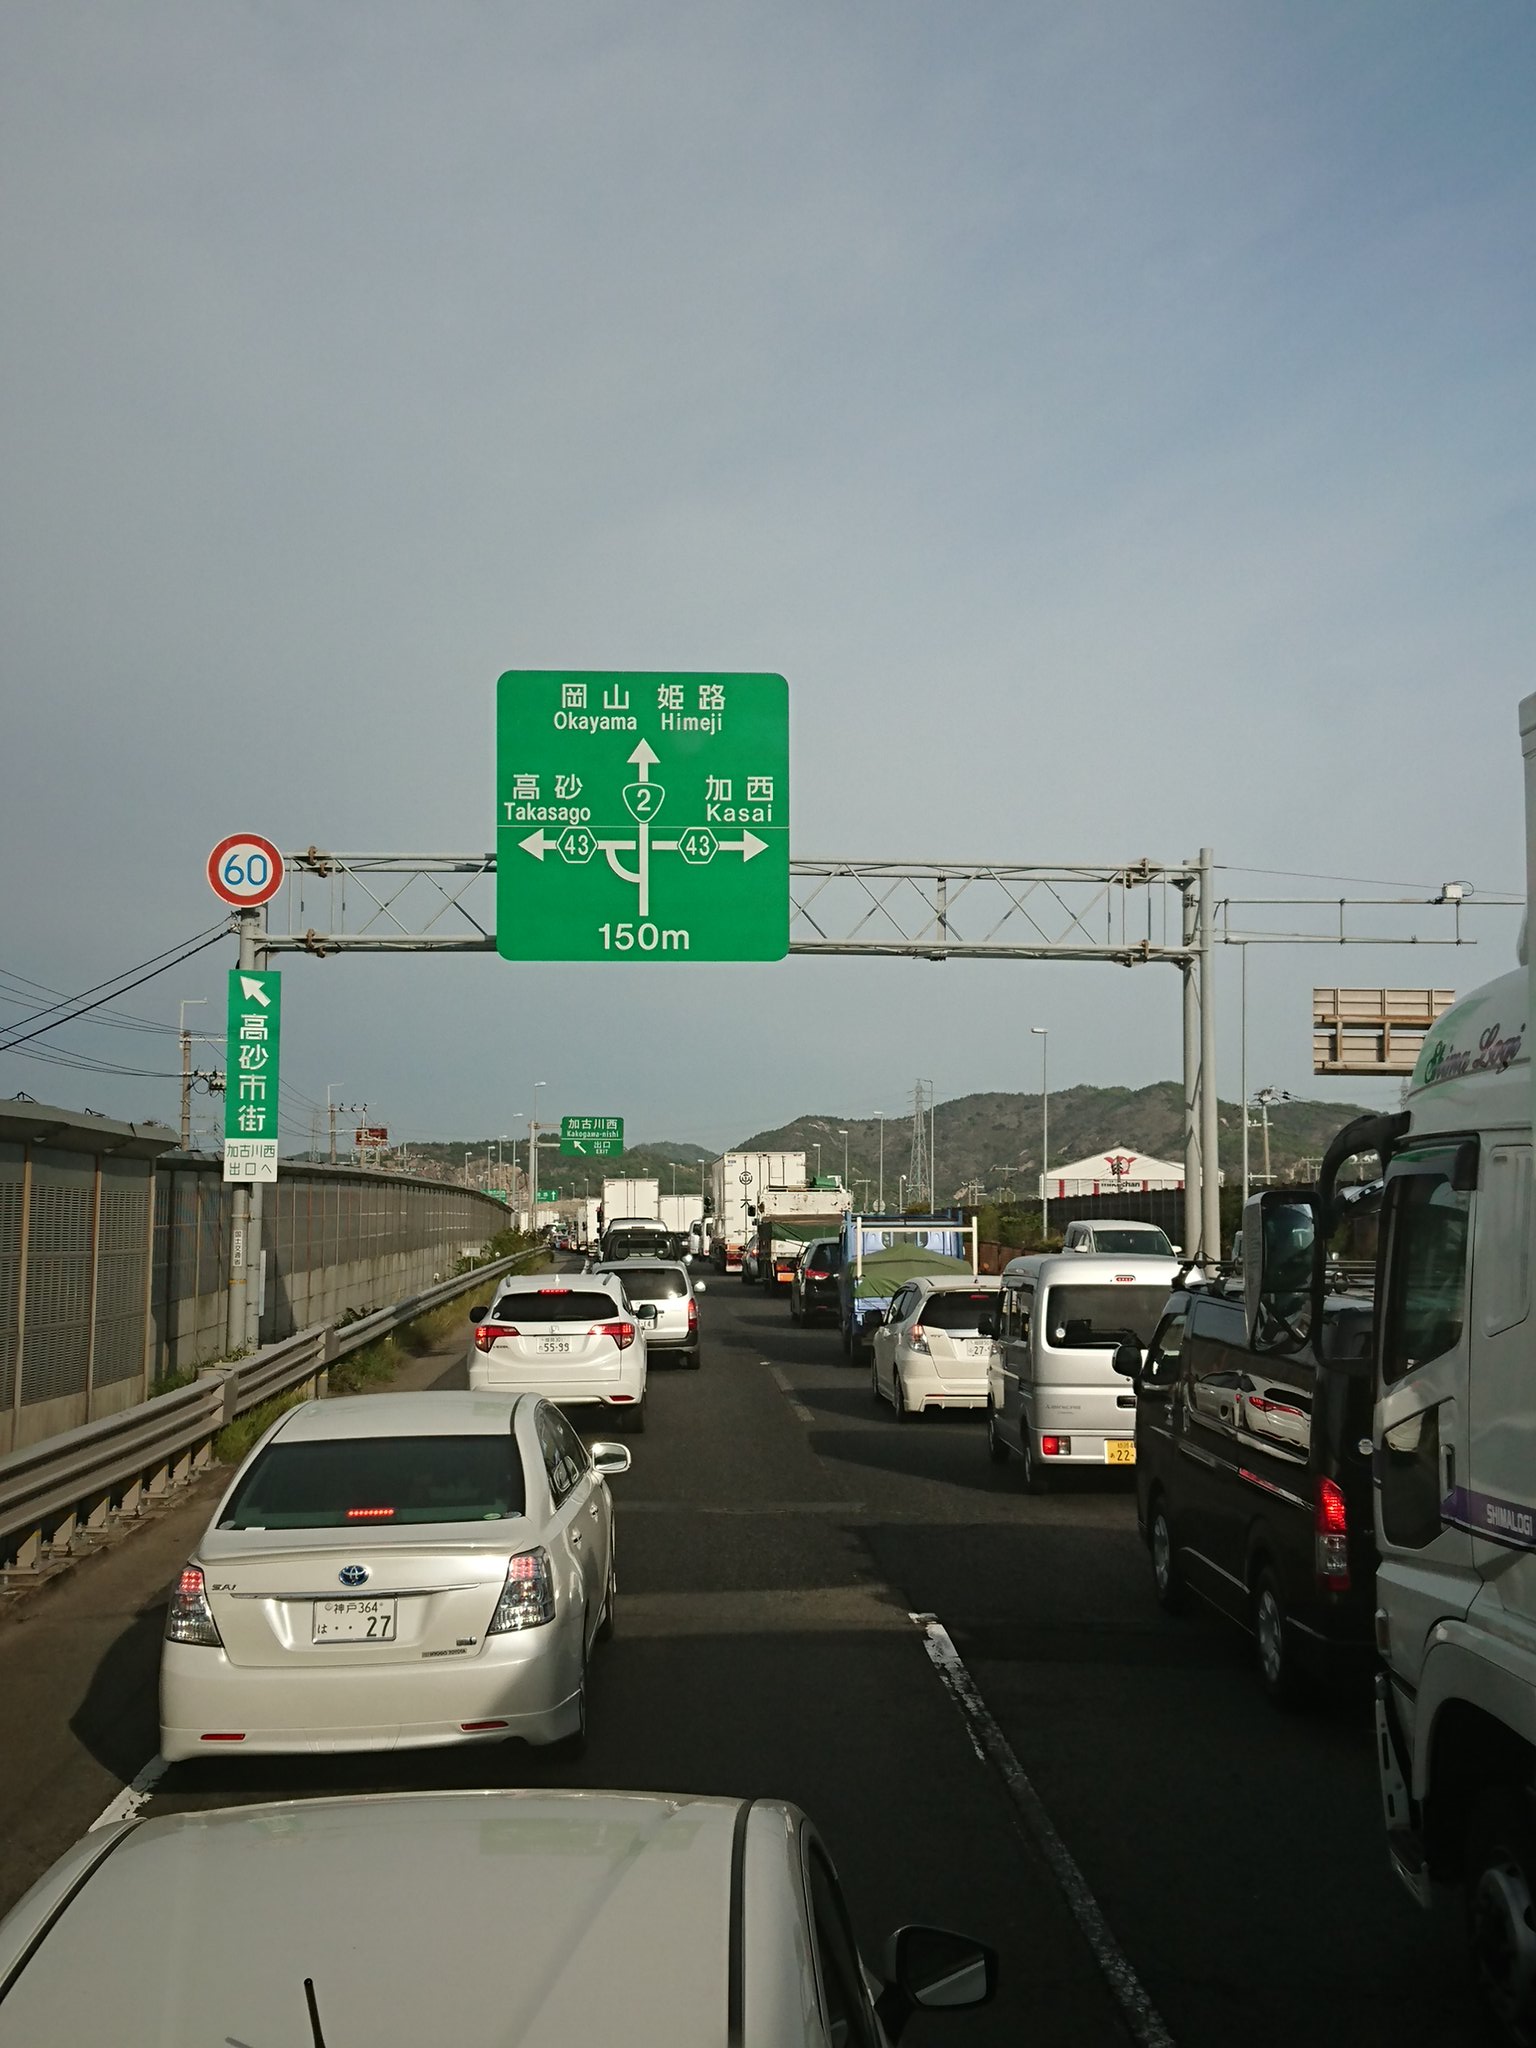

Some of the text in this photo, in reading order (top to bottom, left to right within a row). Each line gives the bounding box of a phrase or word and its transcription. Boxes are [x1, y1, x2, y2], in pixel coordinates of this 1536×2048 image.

[562, 683, 726, 711] 岡山 姫路
[553, 711, 723, 735] Okayama Himeji
[512, 773, 583, 800] 高砂
[705, 774, 774, 801] 加西
[636, 788, 651, 811] 2
[504, 802, 591, 825] Takasago
[706, 803, 773, 822] Kasai
[564, 834, 589, 856] 43
[685, 835, 710, 856] 43
[224, 854, 268, 886] 60
[599, 923, 690, 950] 150m
[238, 1013, 269, 1132] 高砂市街
[566, 1130, 619, 1139] Kakogawa-nishi
[568, 1118, 618, 1130] 加古川西
[226, 1143, 277, 1159] 加古川西
[593, 1141, 611, 1149] 出口
[229, 1162, 272, 1176] 出口へ
[211, 1583, 237, 1591] SAI
